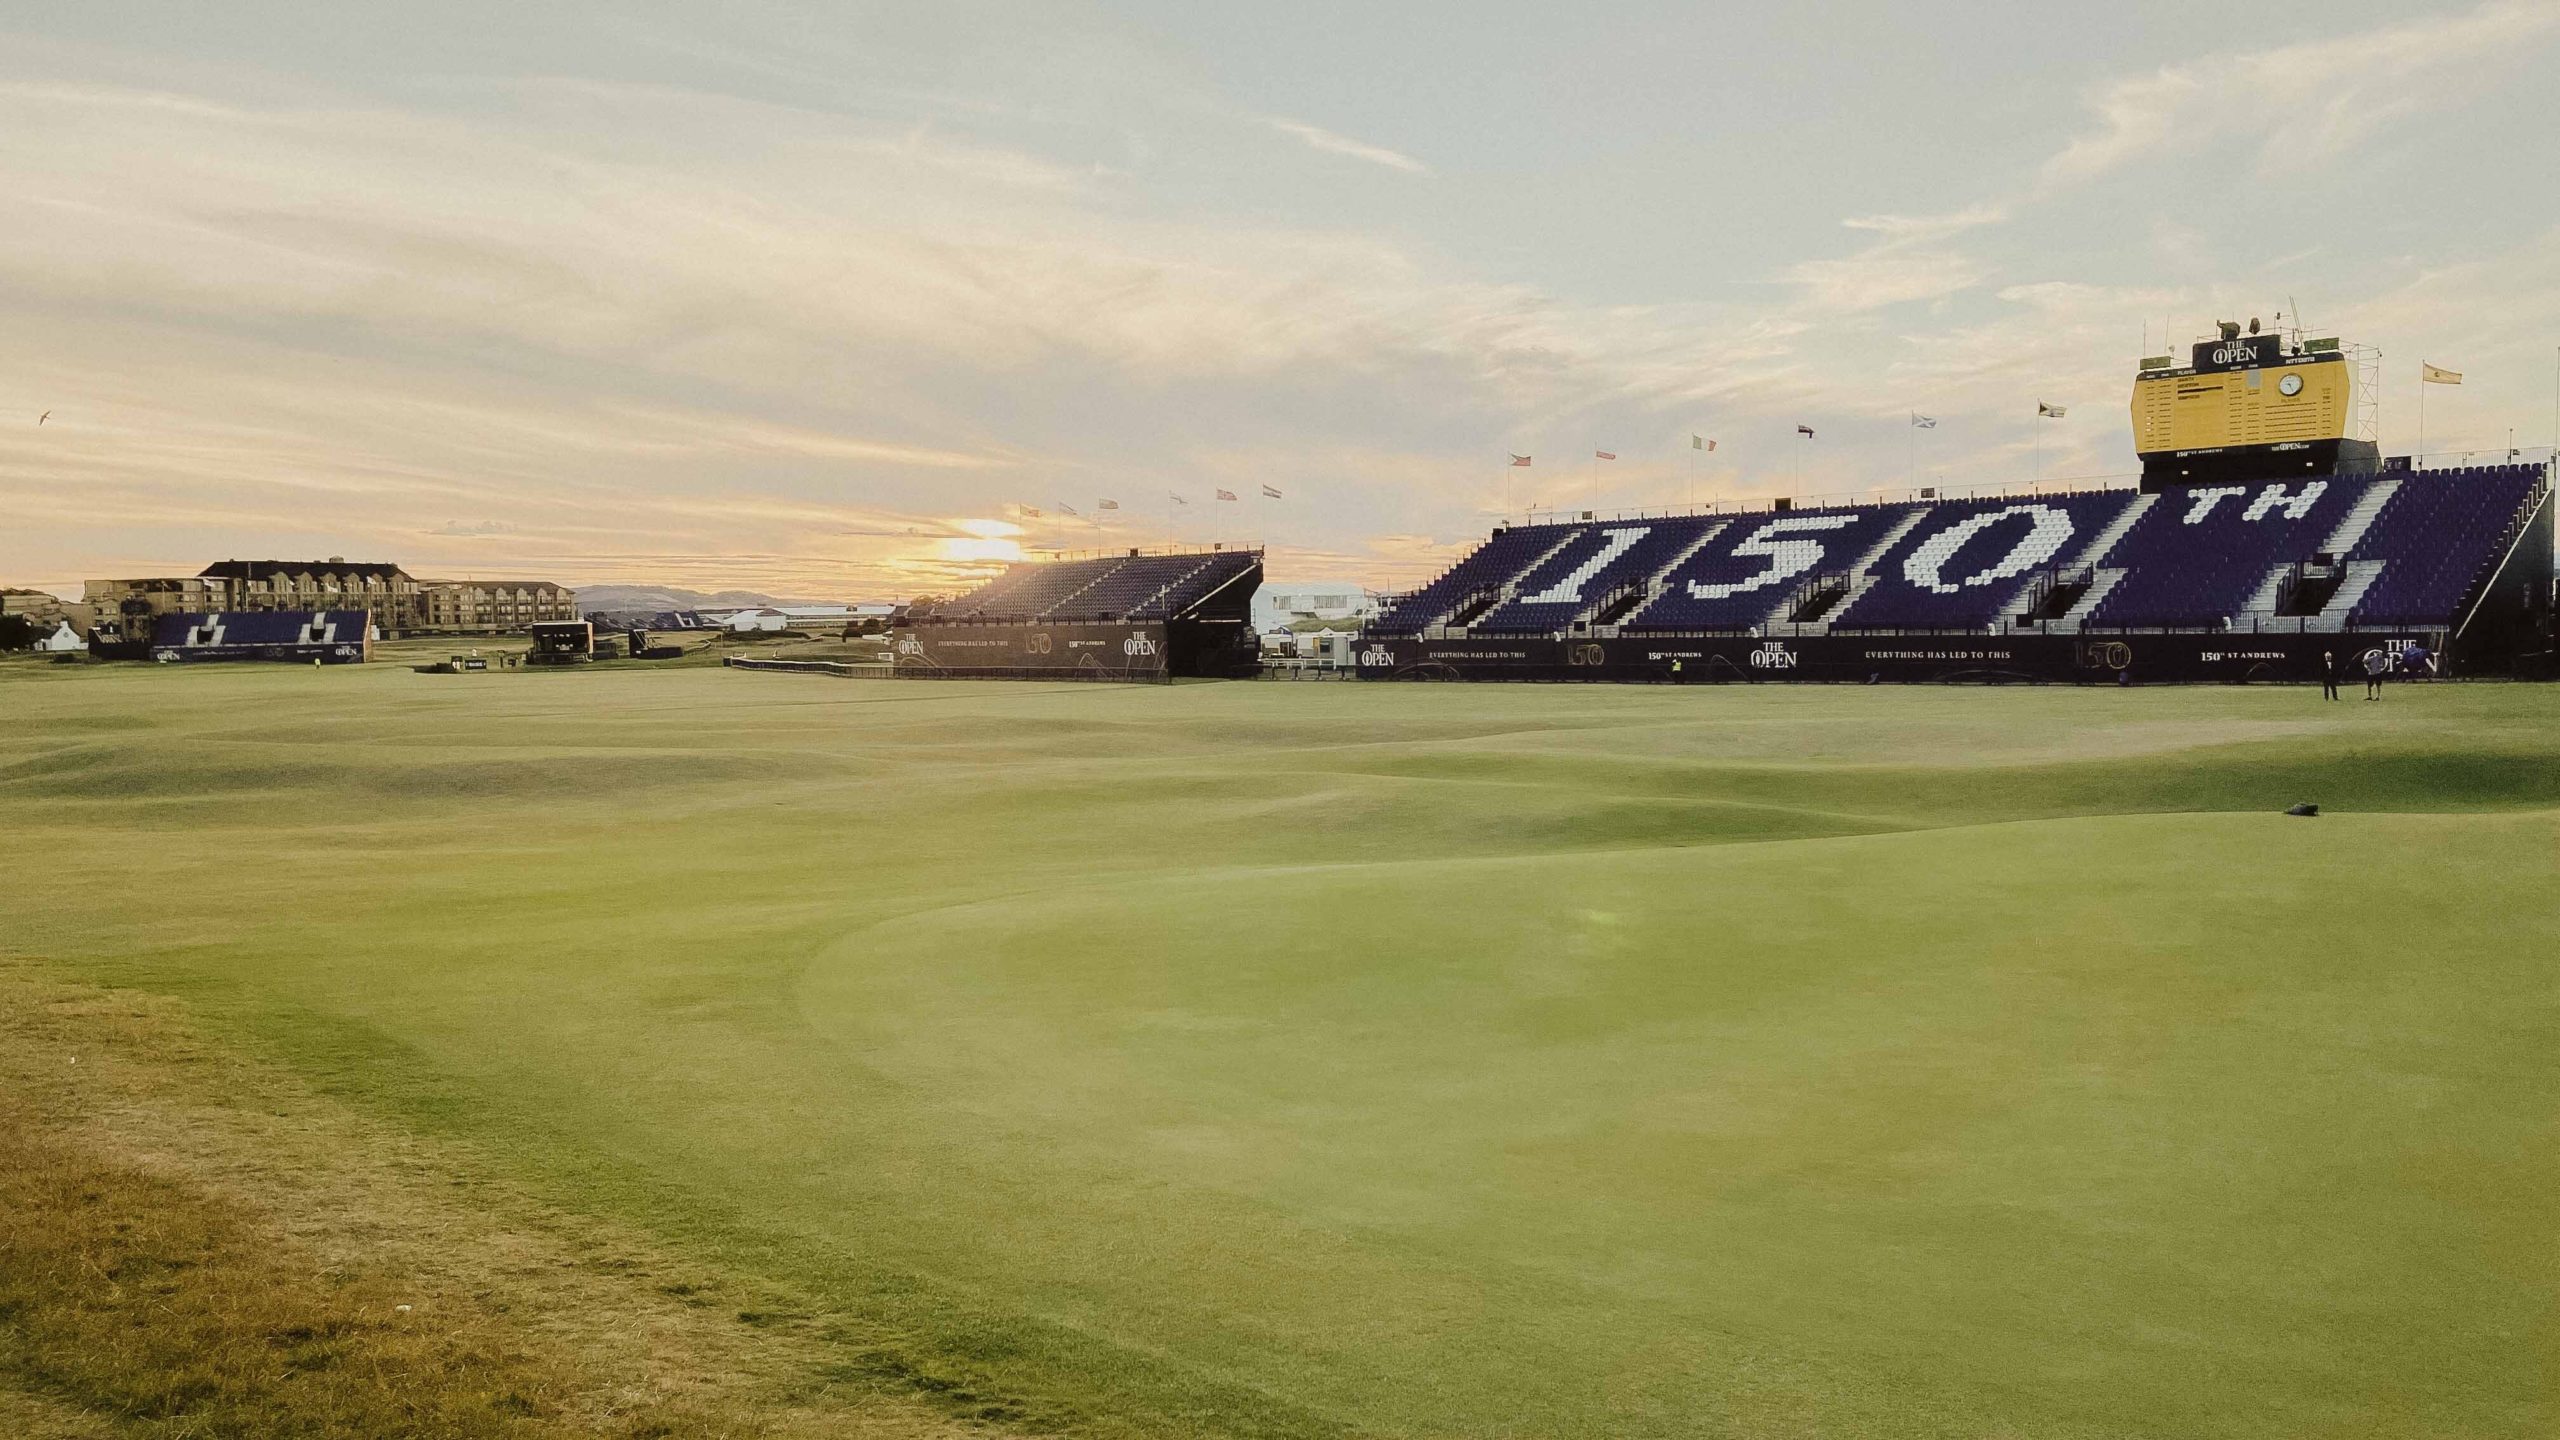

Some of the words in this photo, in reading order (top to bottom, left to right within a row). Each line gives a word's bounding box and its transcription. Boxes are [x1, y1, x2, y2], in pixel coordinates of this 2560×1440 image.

[2226, 340, 2245, 350] THE
[2212, 346, 2257, 364] OPEN
[1133, 632, 1146, 640] THE
[899, 640, 923, 654] OPEN
[1124, 639, 1156, 655] OPEN
[1370, 644, 1385, 652] THE
[1763, 642, 1783, 652] THE
[1361, 651, 1394, 666] OPEN
[1750, 650, 1797, 668] OPEN
[1865, 651, 1924, 659] EVERYTHING
[1927, 651, 1946, 659] HAS
[1950, 651, 1967, 659] LED
[1971, 651, 1984, 659] TO
[1988, 651, 2011, 659] THIS
